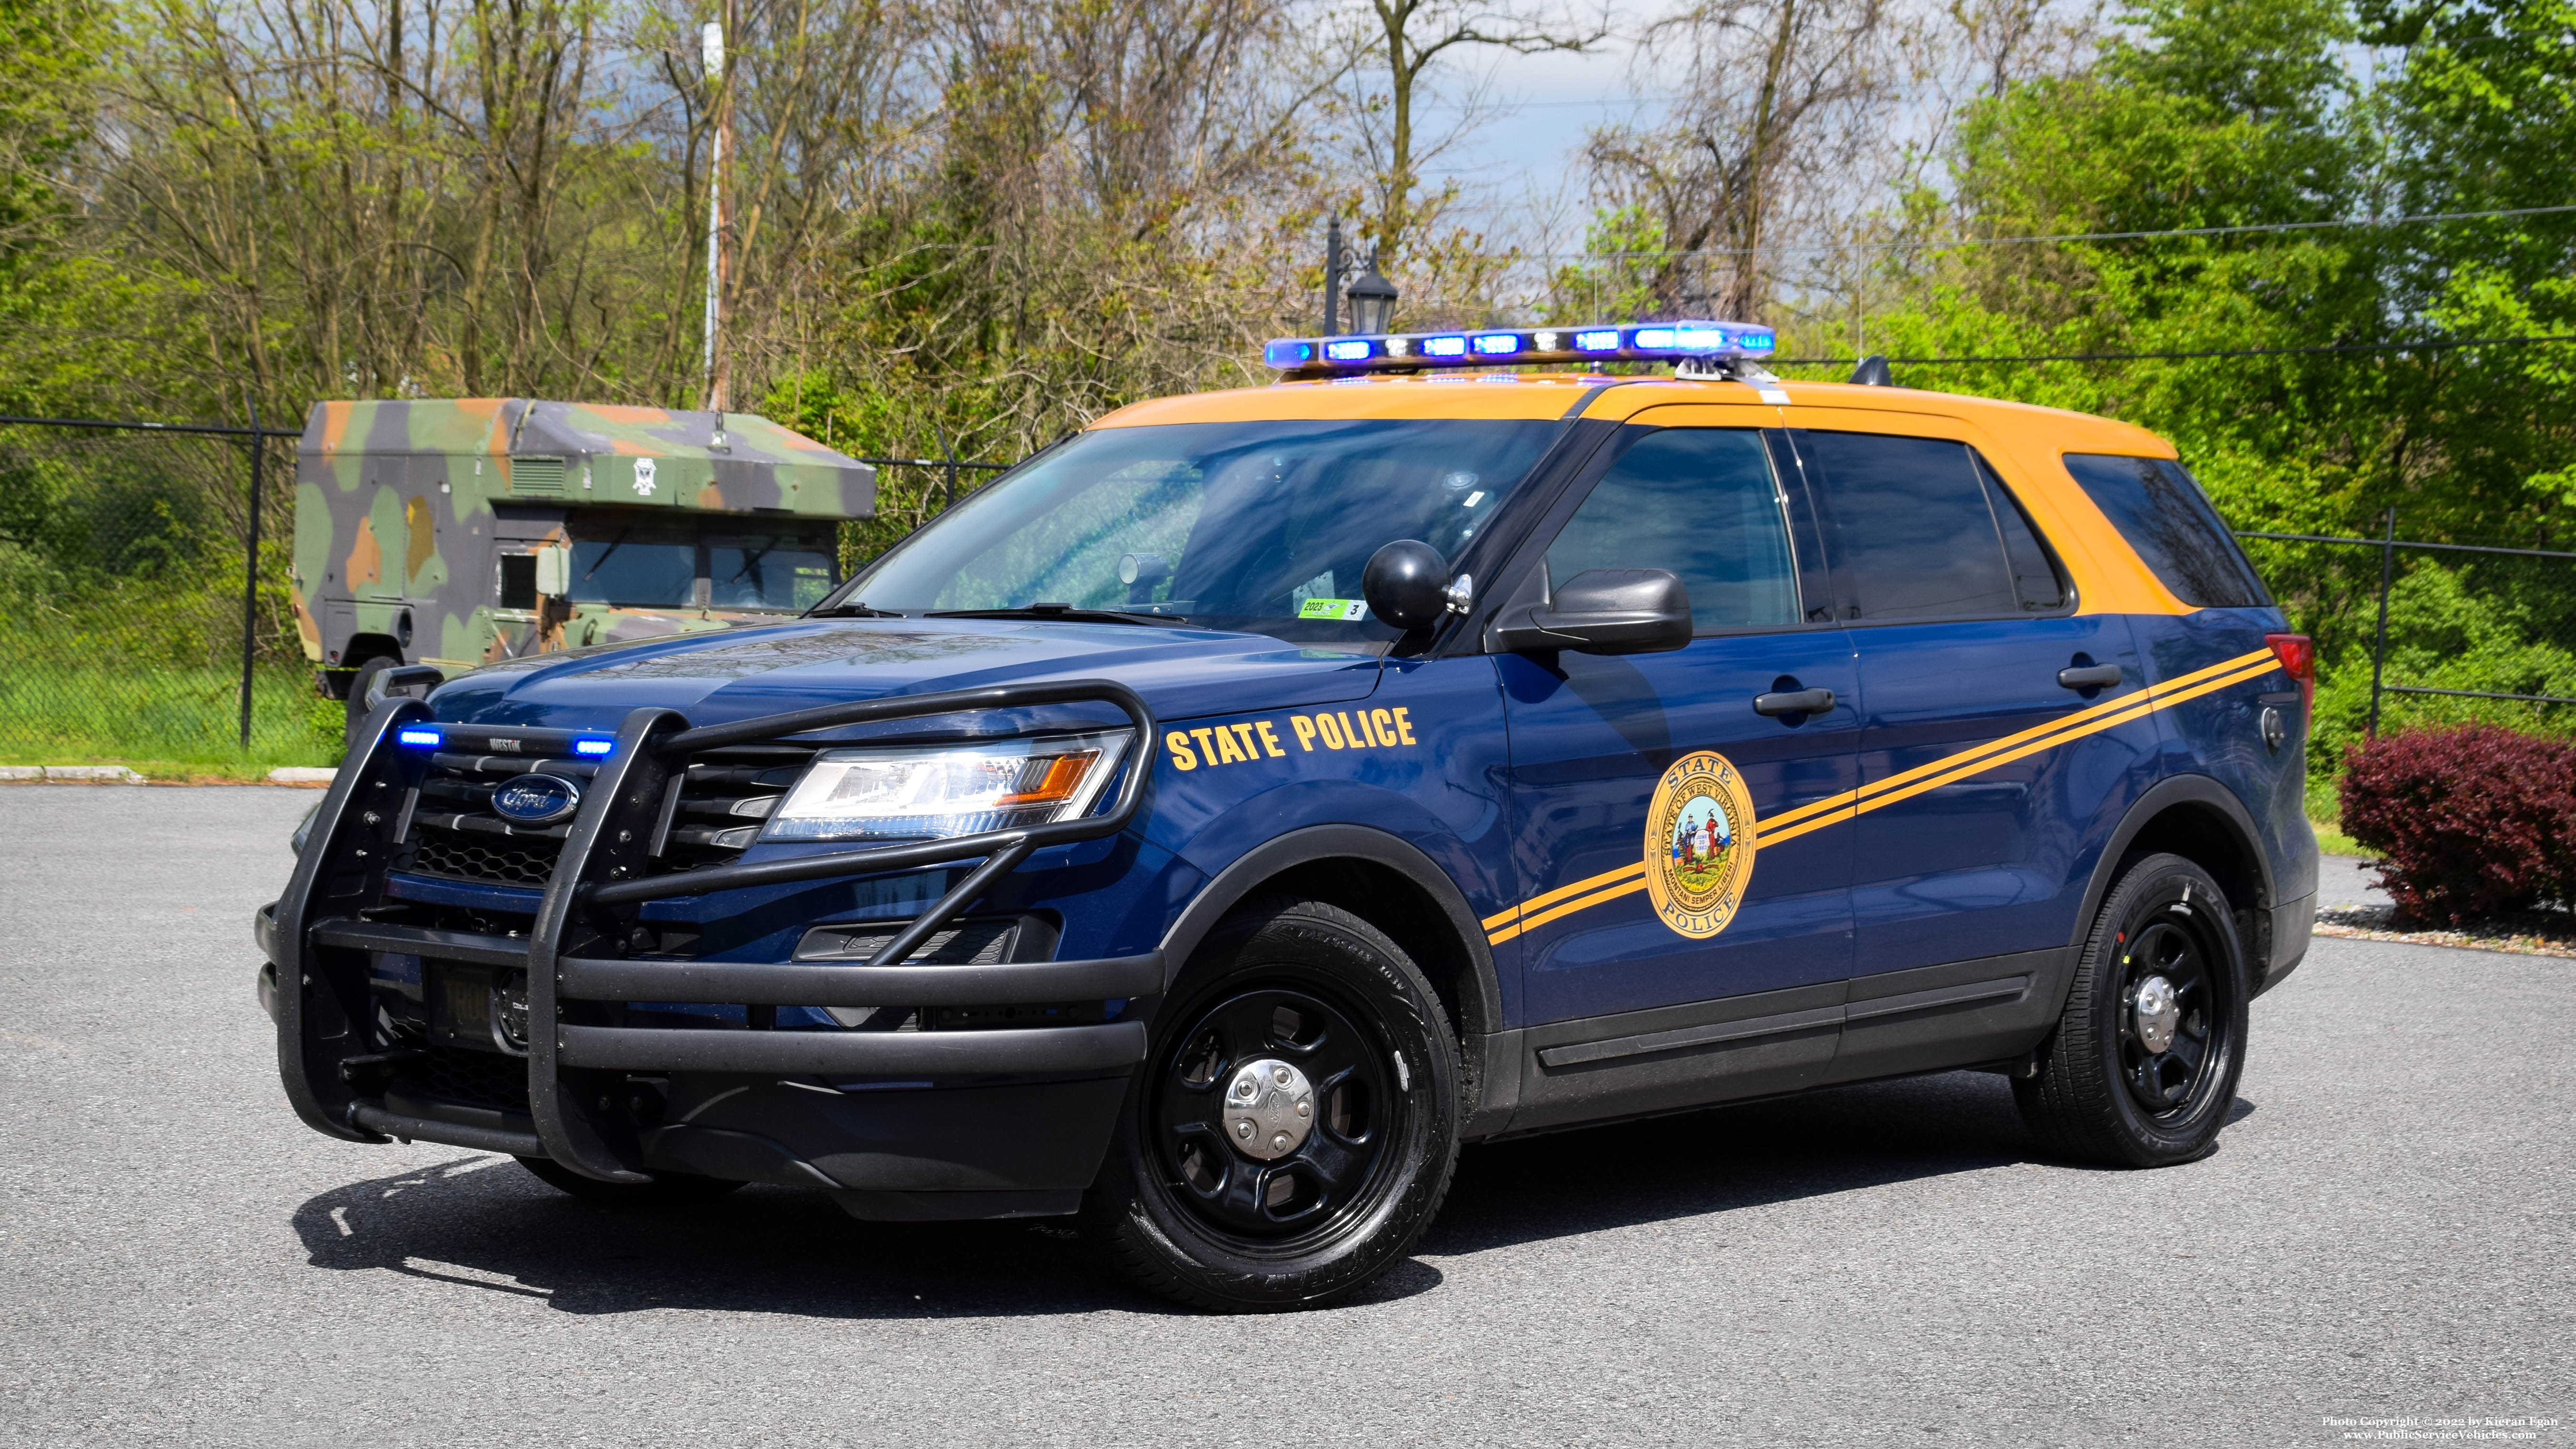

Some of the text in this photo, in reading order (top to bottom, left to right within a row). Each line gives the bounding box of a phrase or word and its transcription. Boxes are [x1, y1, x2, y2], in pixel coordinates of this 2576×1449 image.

[1304, 602, 1324, 611] 2023
[1351, 605, 1359, 615] 3
[1166, 707, 1417, 771] STATE POLICE
[1668, 758, 1733, 790] STATE
[502, 786, 554, 808] Ford
[1665, 784, 1737, 856] STATE OF WEST VIRGINIA
[1667, 862, 1734, 904] MONTANI SEMPER LIBERI
[1662, 892, 1736, 931] POLICE
